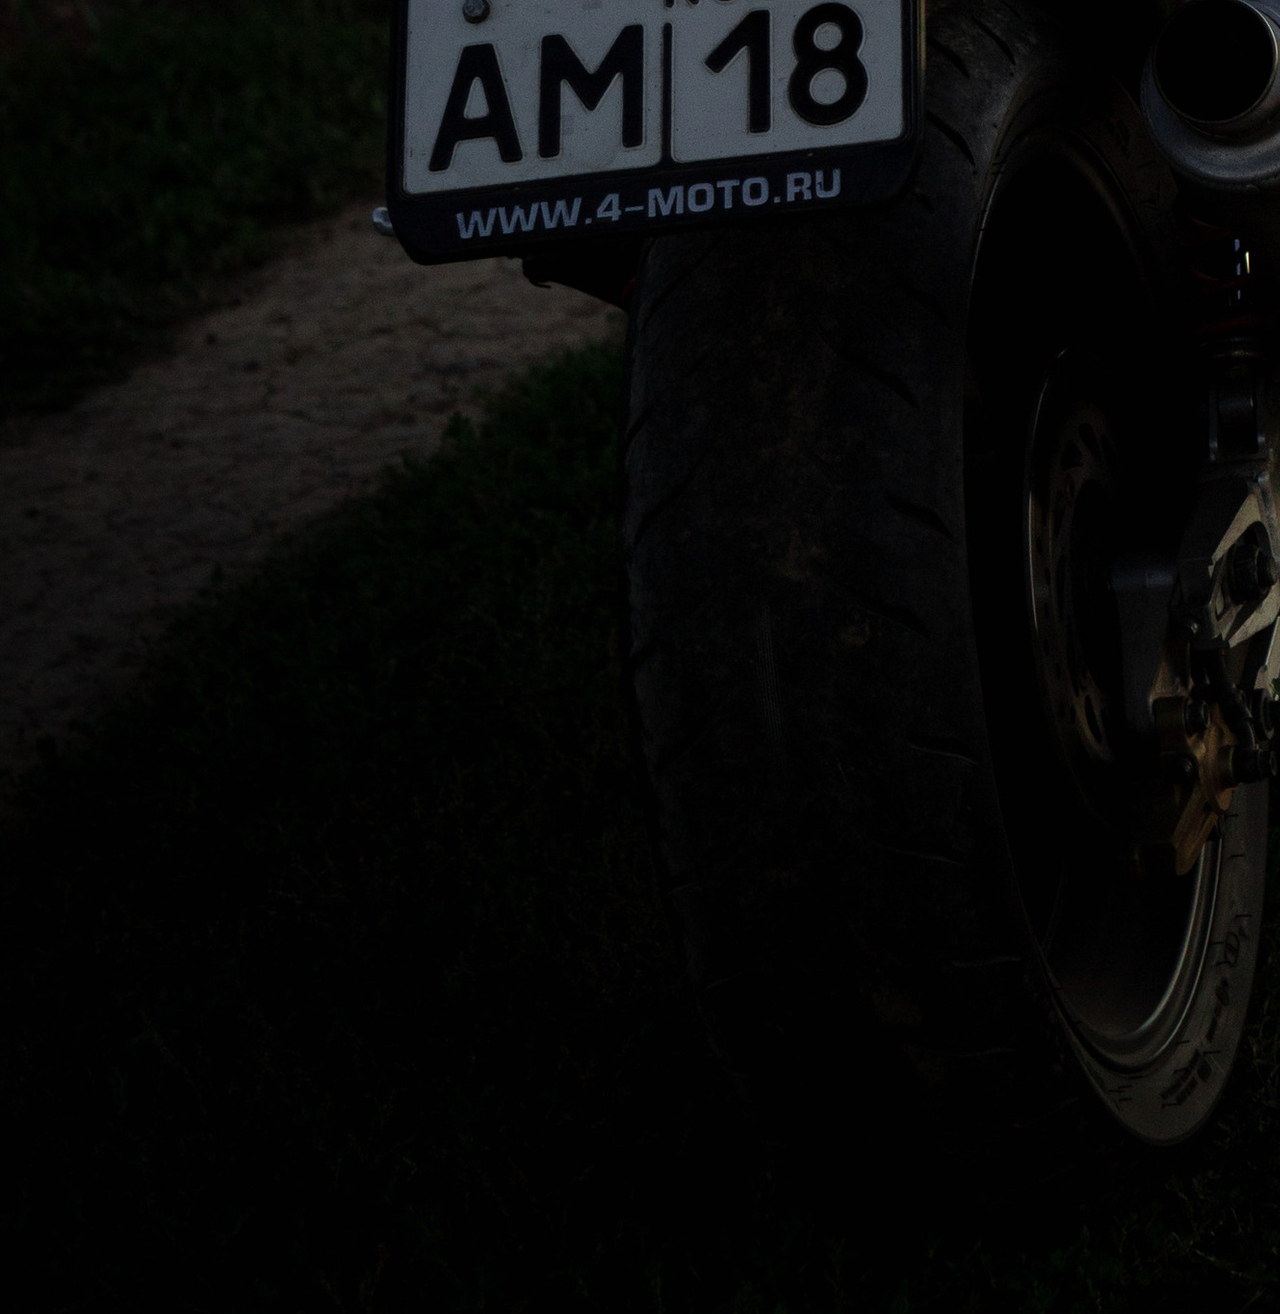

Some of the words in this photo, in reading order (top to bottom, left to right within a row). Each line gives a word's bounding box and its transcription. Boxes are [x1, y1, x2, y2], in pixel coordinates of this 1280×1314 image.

[429, 23, 644, 172] AM
[704, 3, 868, 134] 18
[456, 169, 842, 239] WWW.4-MOTO.RU
